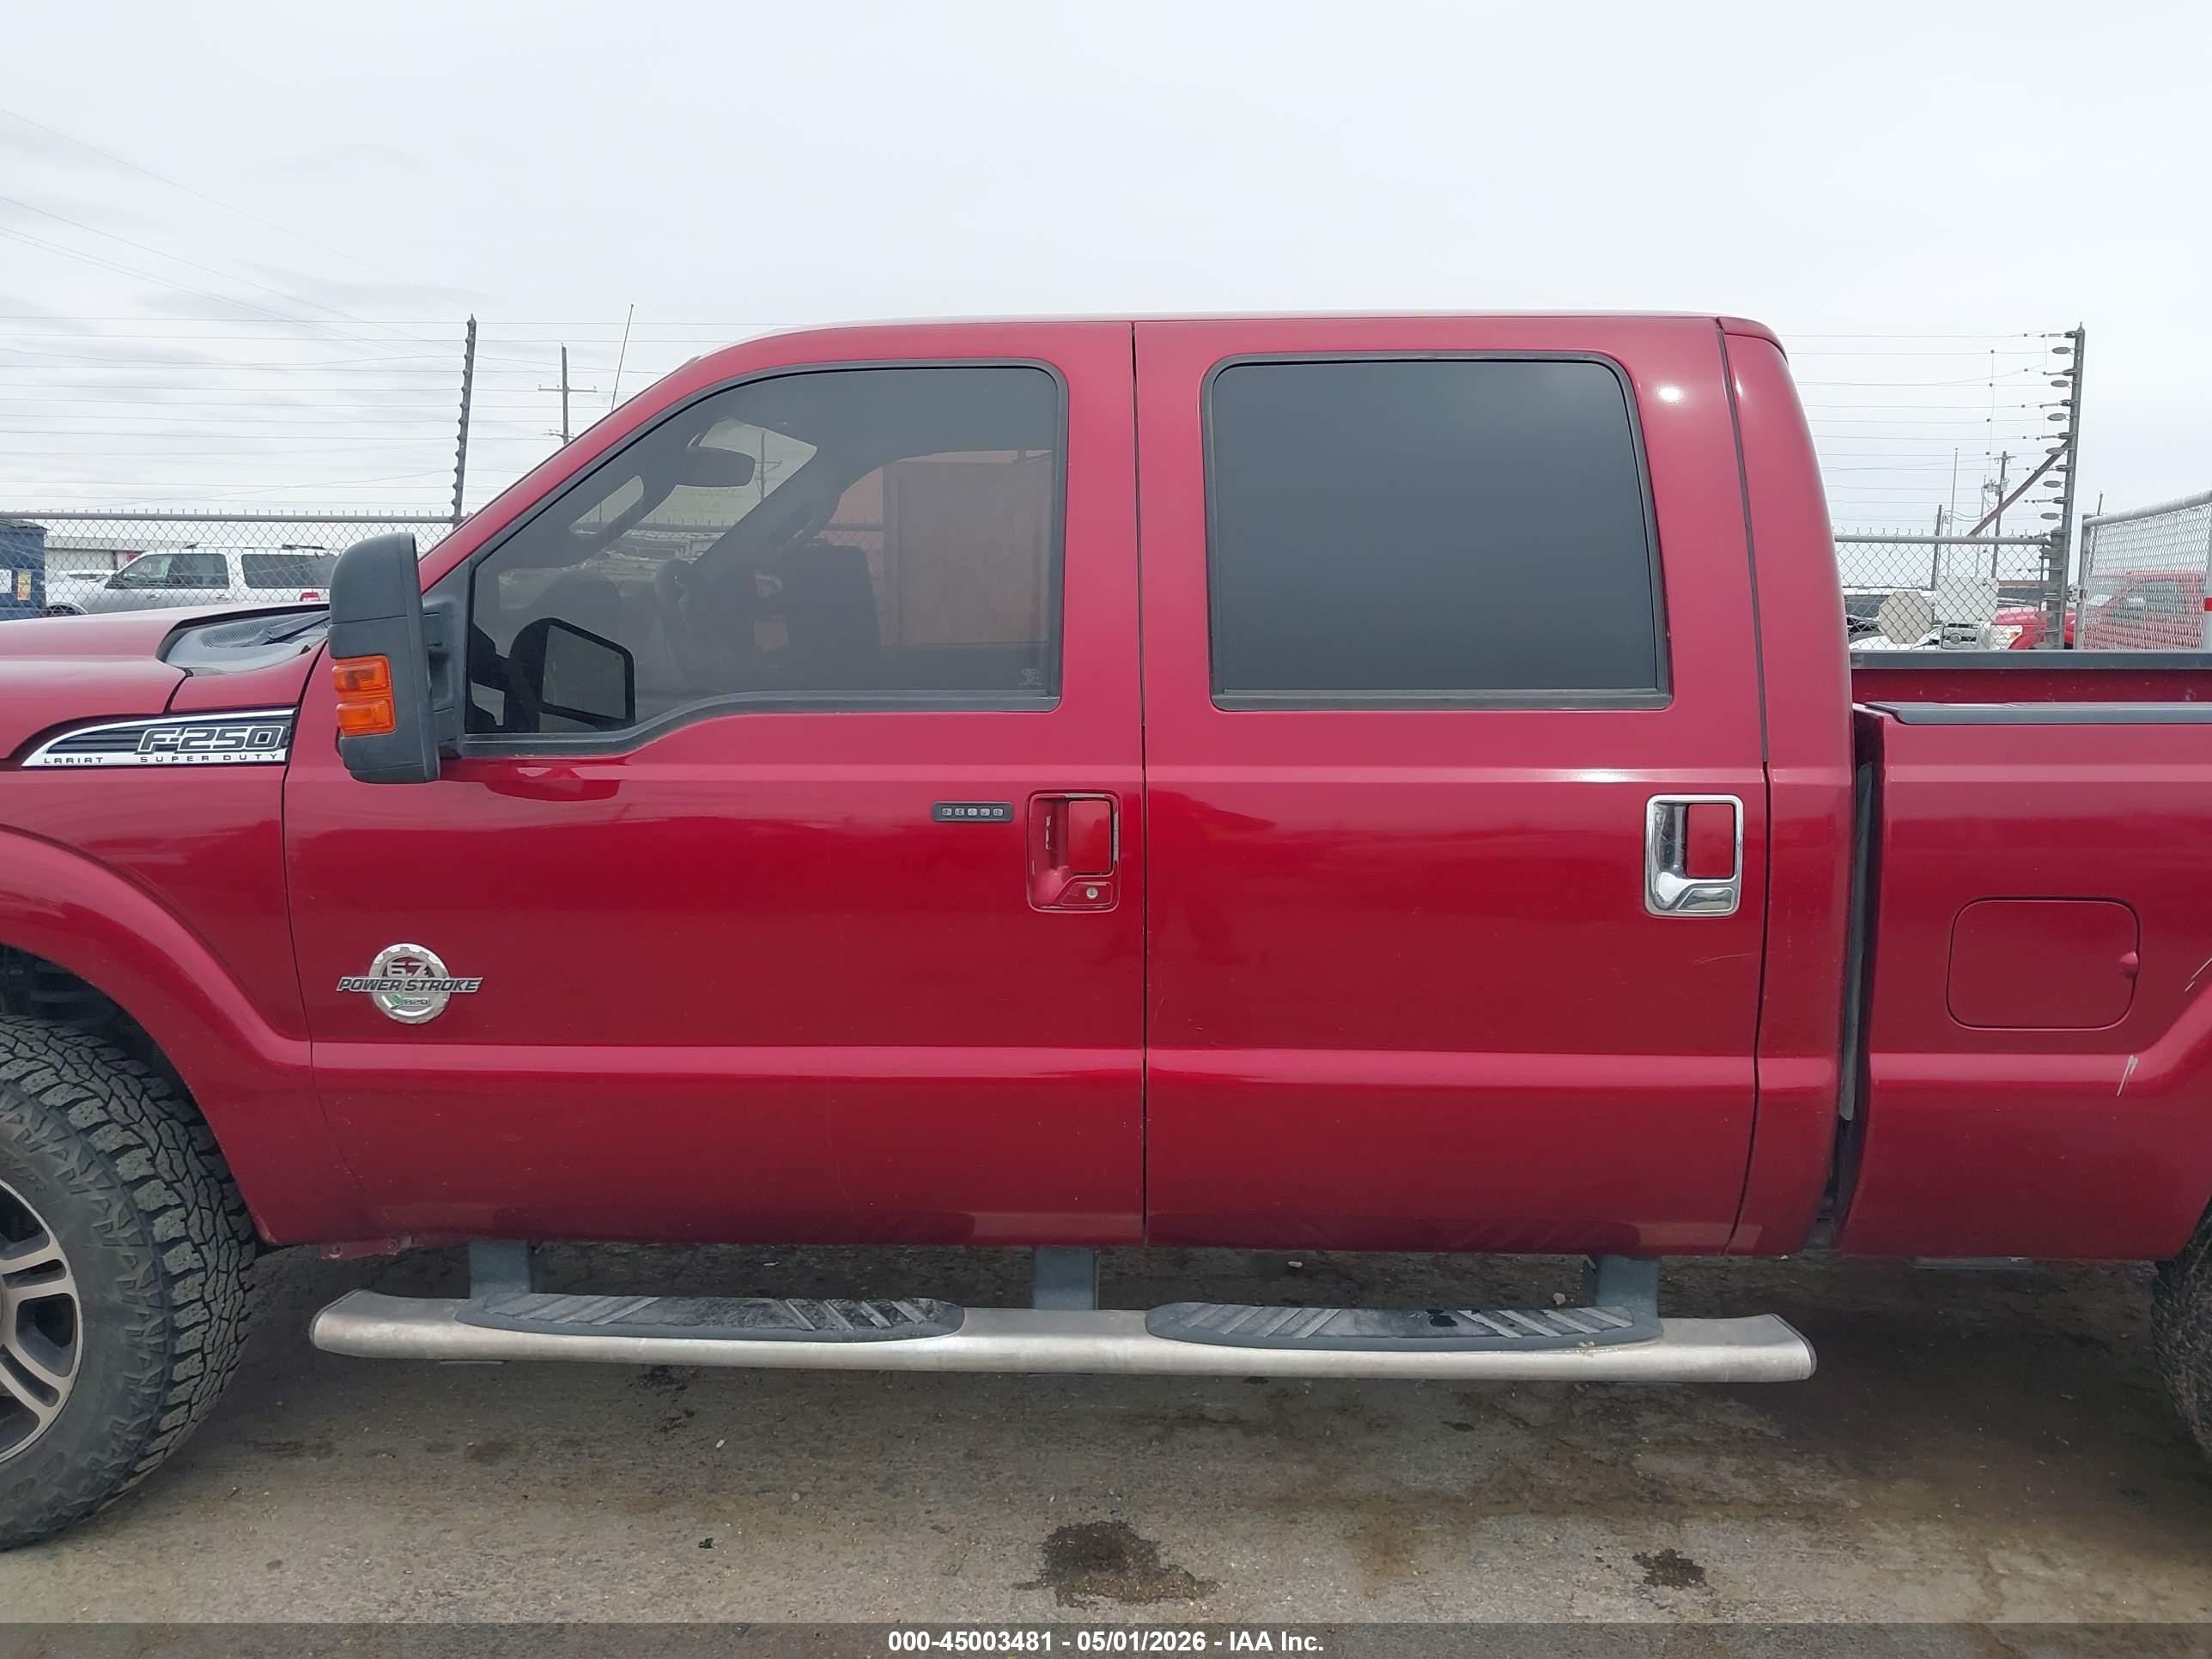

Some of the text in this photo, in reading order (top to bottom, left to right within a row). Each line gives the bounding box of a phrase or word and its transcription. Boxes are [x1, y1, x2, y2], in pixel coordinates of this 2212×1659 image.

[137, 726, 285, 754] F-250
[140, 755, 210, 763] SUPER
[338, 978, 482, 992] POWER STROKE
